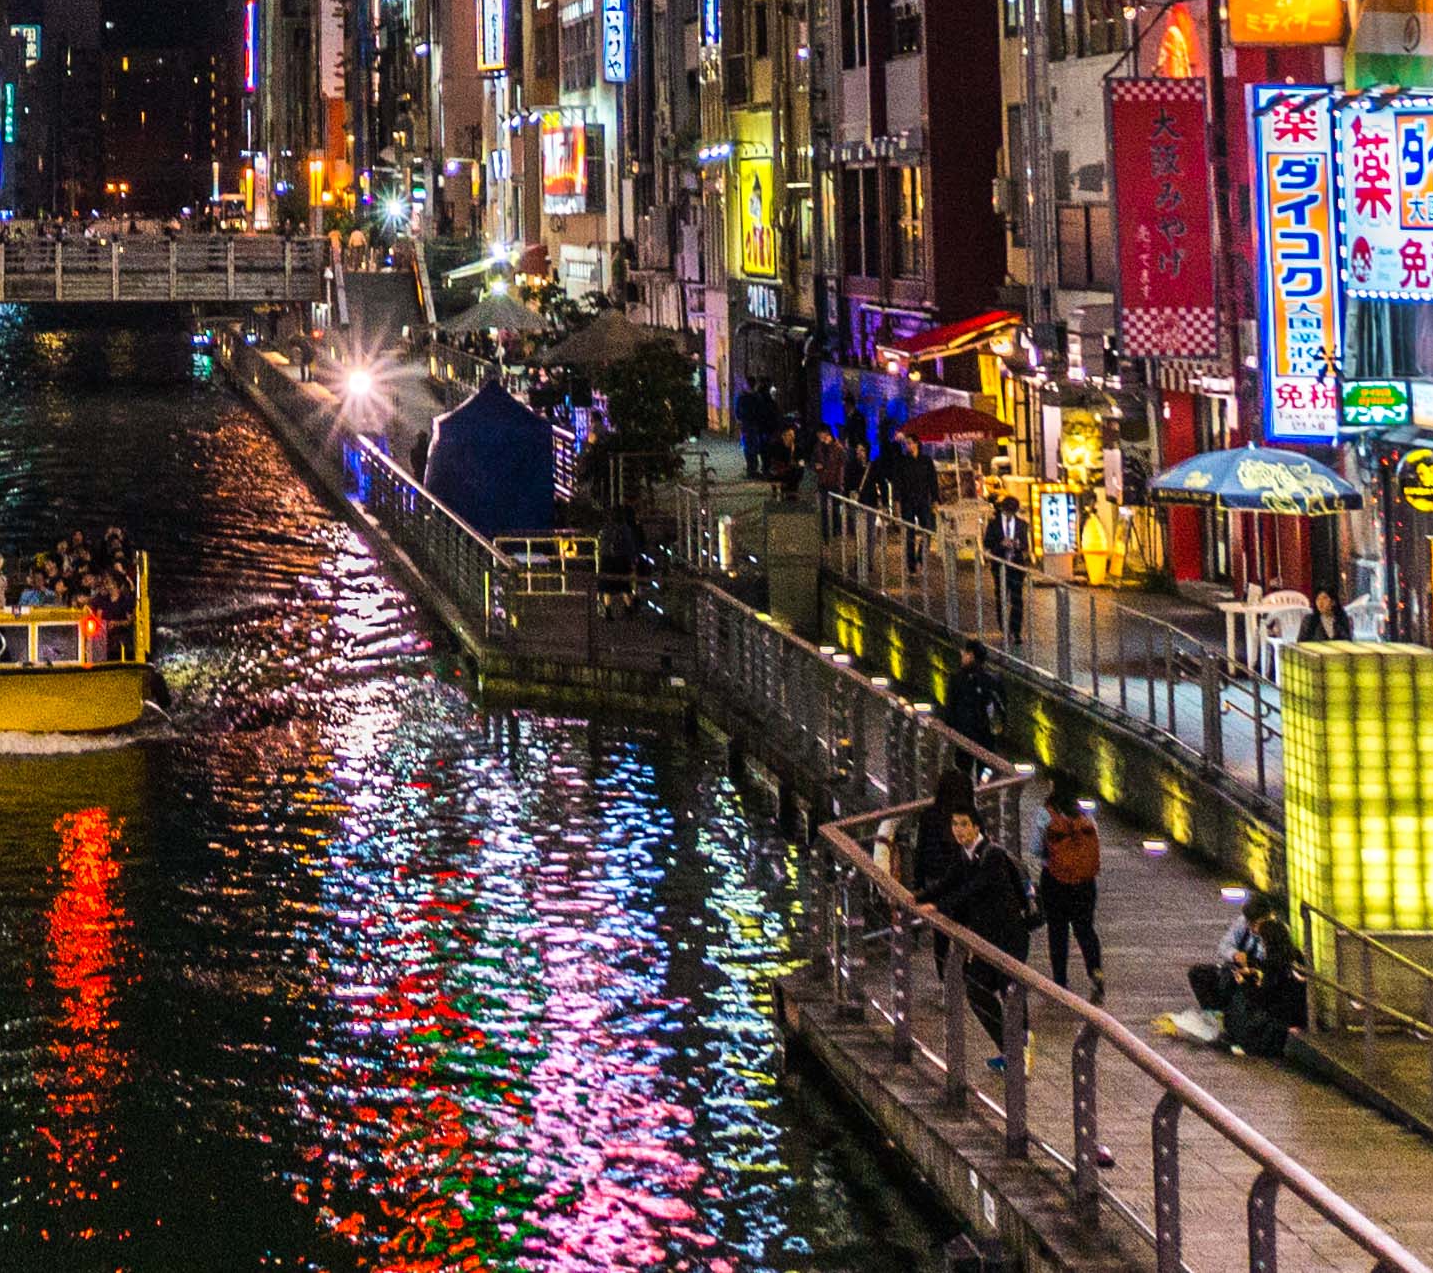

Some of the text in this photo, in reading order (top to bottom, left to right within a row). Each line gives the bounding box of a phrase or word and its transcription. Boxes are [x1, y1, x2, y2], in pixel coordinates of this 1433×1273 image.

[1275, 153, 1324, 299] ダイコク
[1350, 114, 1394, 221] 薬
